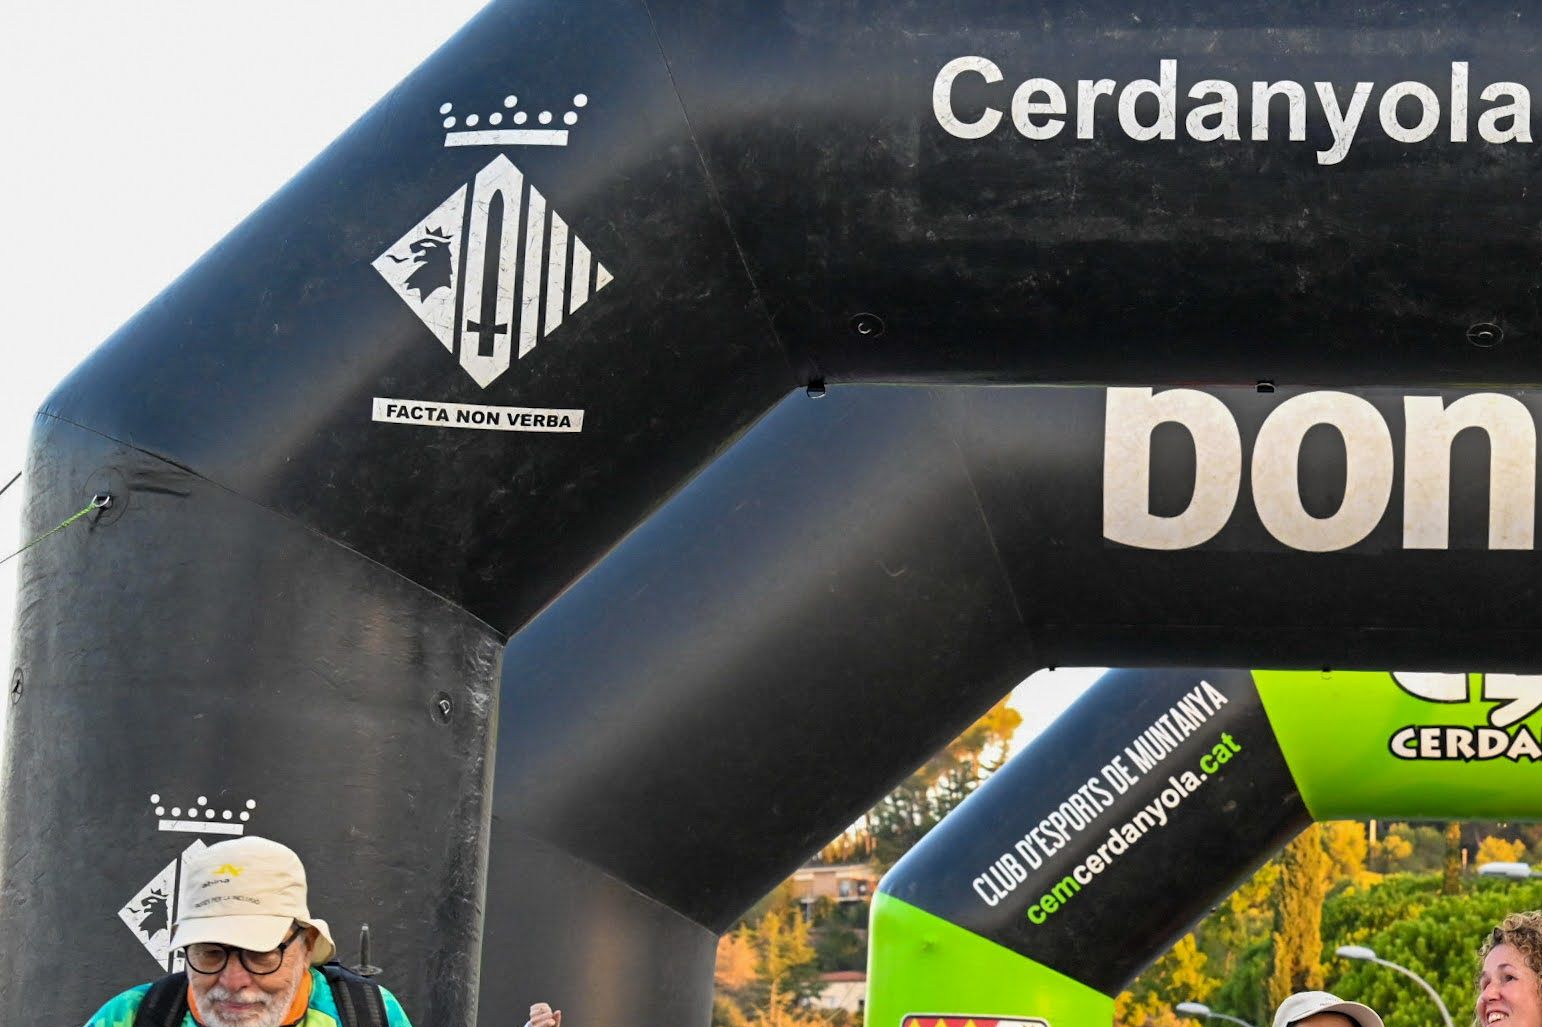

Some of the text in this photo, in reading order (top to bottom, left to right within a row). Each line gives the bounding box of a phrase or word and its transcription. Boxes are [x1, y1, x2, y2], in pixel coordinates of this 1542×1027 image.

[932, 55, 1533, 165] Cerdanyola
[386, 404, 573, 428] FACTA NON VERBA
[972, 680, 1229, 907] CLUB D'ESPORTS DE MUNTANYA
[1027, 732, 1242, 925] cemcerdanyola.cat
